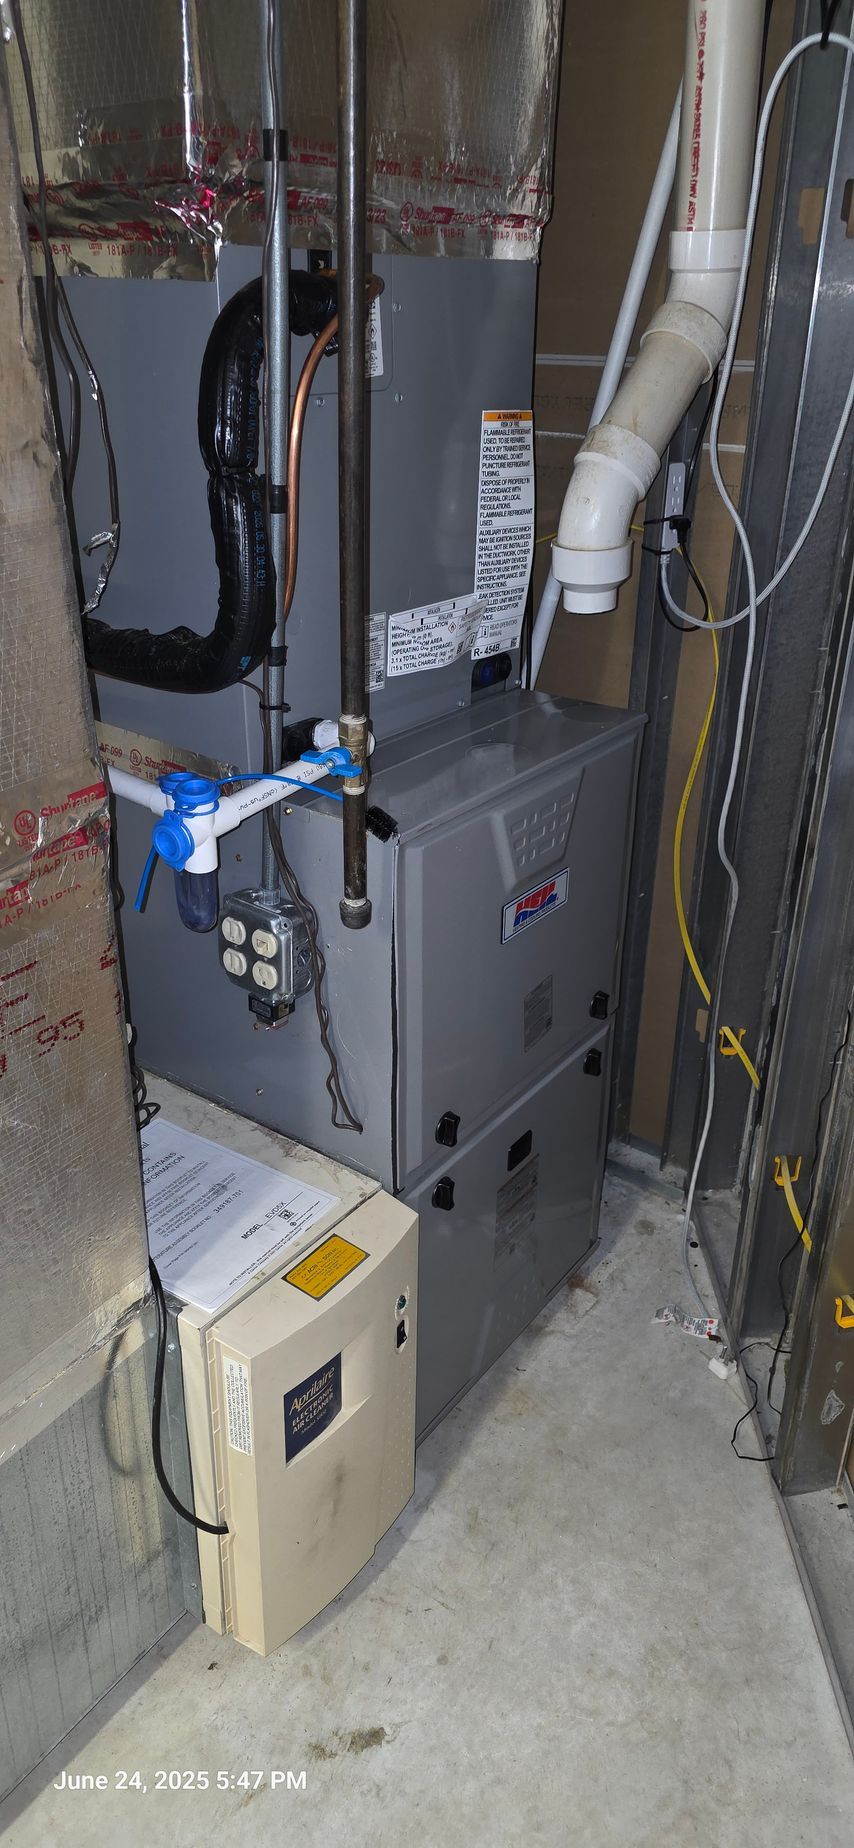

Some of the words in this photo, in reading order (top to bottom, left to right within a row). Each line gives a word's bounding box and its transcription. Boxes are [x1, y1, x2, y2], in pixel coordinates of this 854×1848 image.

[484, 428, 510, 436] FLAMMABLE
[507, 460, 530, 468] REFRIGERANT
[480, 486, 511, 494] ACCORDANCE
[507, 508, 533, 516] REFRIGERANT
[513, 533, 531, 541] SOURCES
[509, 541, 529, 549] INSTALLED
[489, 590, 510, 598] DETECTION
[510, 587, 524, 595] SYSTEM
[416, 620, 448, 633] INSTALLATION
[391, 645, 420, 656] (OPERATING
[484, 643, 500, 654] 454B
[403, 654, 417, 662] TOTAL
[403, 661, 418, 670] TOTAL
[418, 658, 437, 667] CHARGE
[110, 746, 123, 758] 099
[40, 791, 96, 818] Shurtape
[143, 1151, 177, 1176] CONTAINS
[144, 1154, 185, 1185] NFORMATION
[214, 1190, 244, 1214] 349187-701
[241, 1222, 263, 1240] MODEL
[289, 1366, 335, 1416] Aprilaire
[292, 1384, 334, 1426] ELECTRONIC
[292, 1418, 305, 1435] AIR
[306, 1392, 334, 1422] CLEANER
